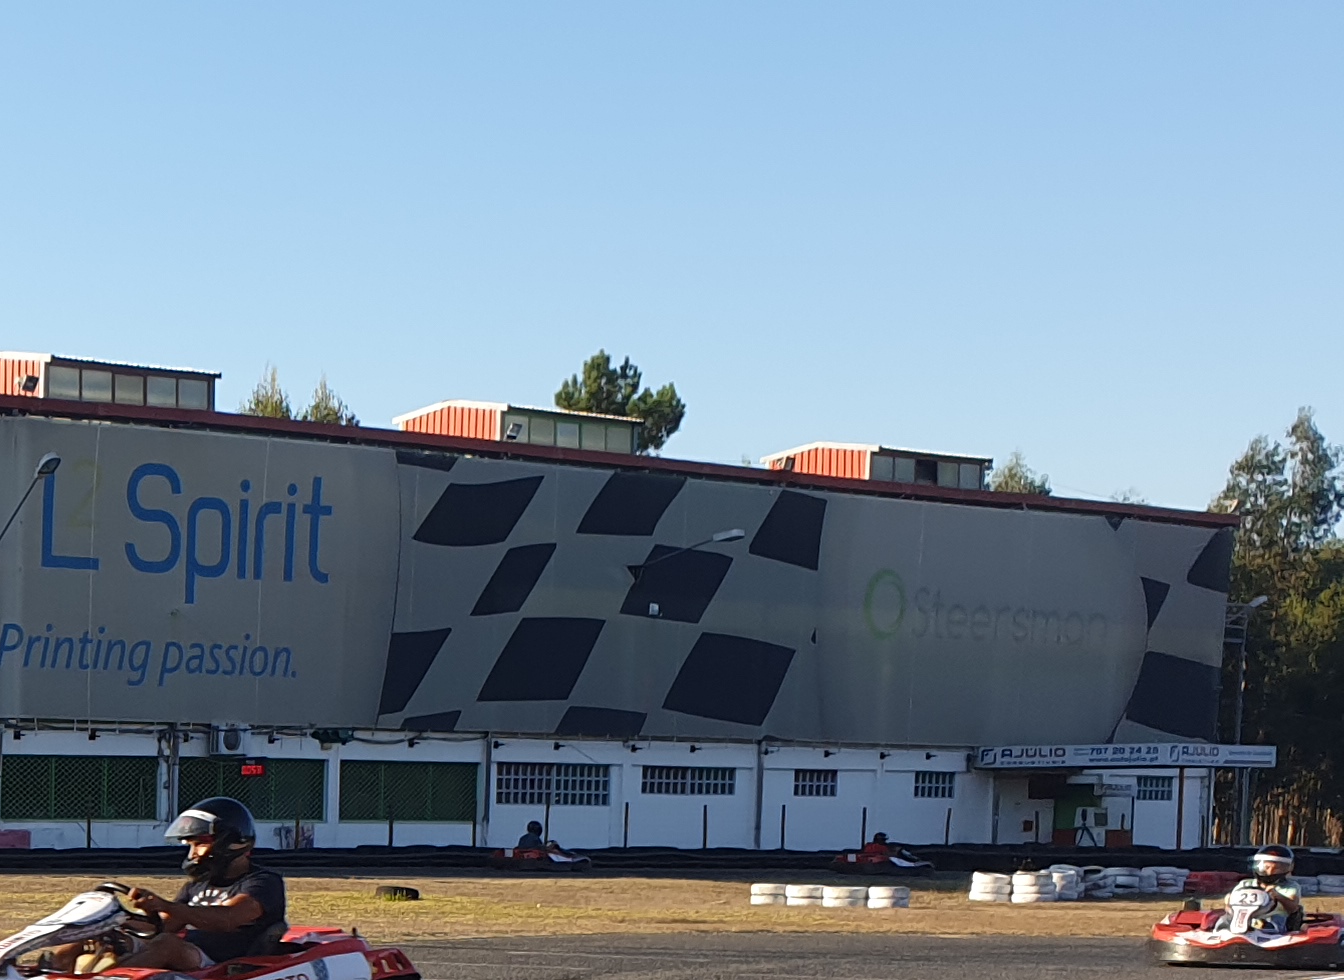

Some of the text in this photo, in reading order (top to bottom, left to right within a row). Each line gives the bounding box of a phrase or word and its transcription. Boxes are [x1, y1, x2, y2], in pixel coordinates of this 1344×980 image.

[124, 462, 332, 604] Spirit
[158, 634, 298, 687] passion.
[1239, 893, 1258, 904] 23
